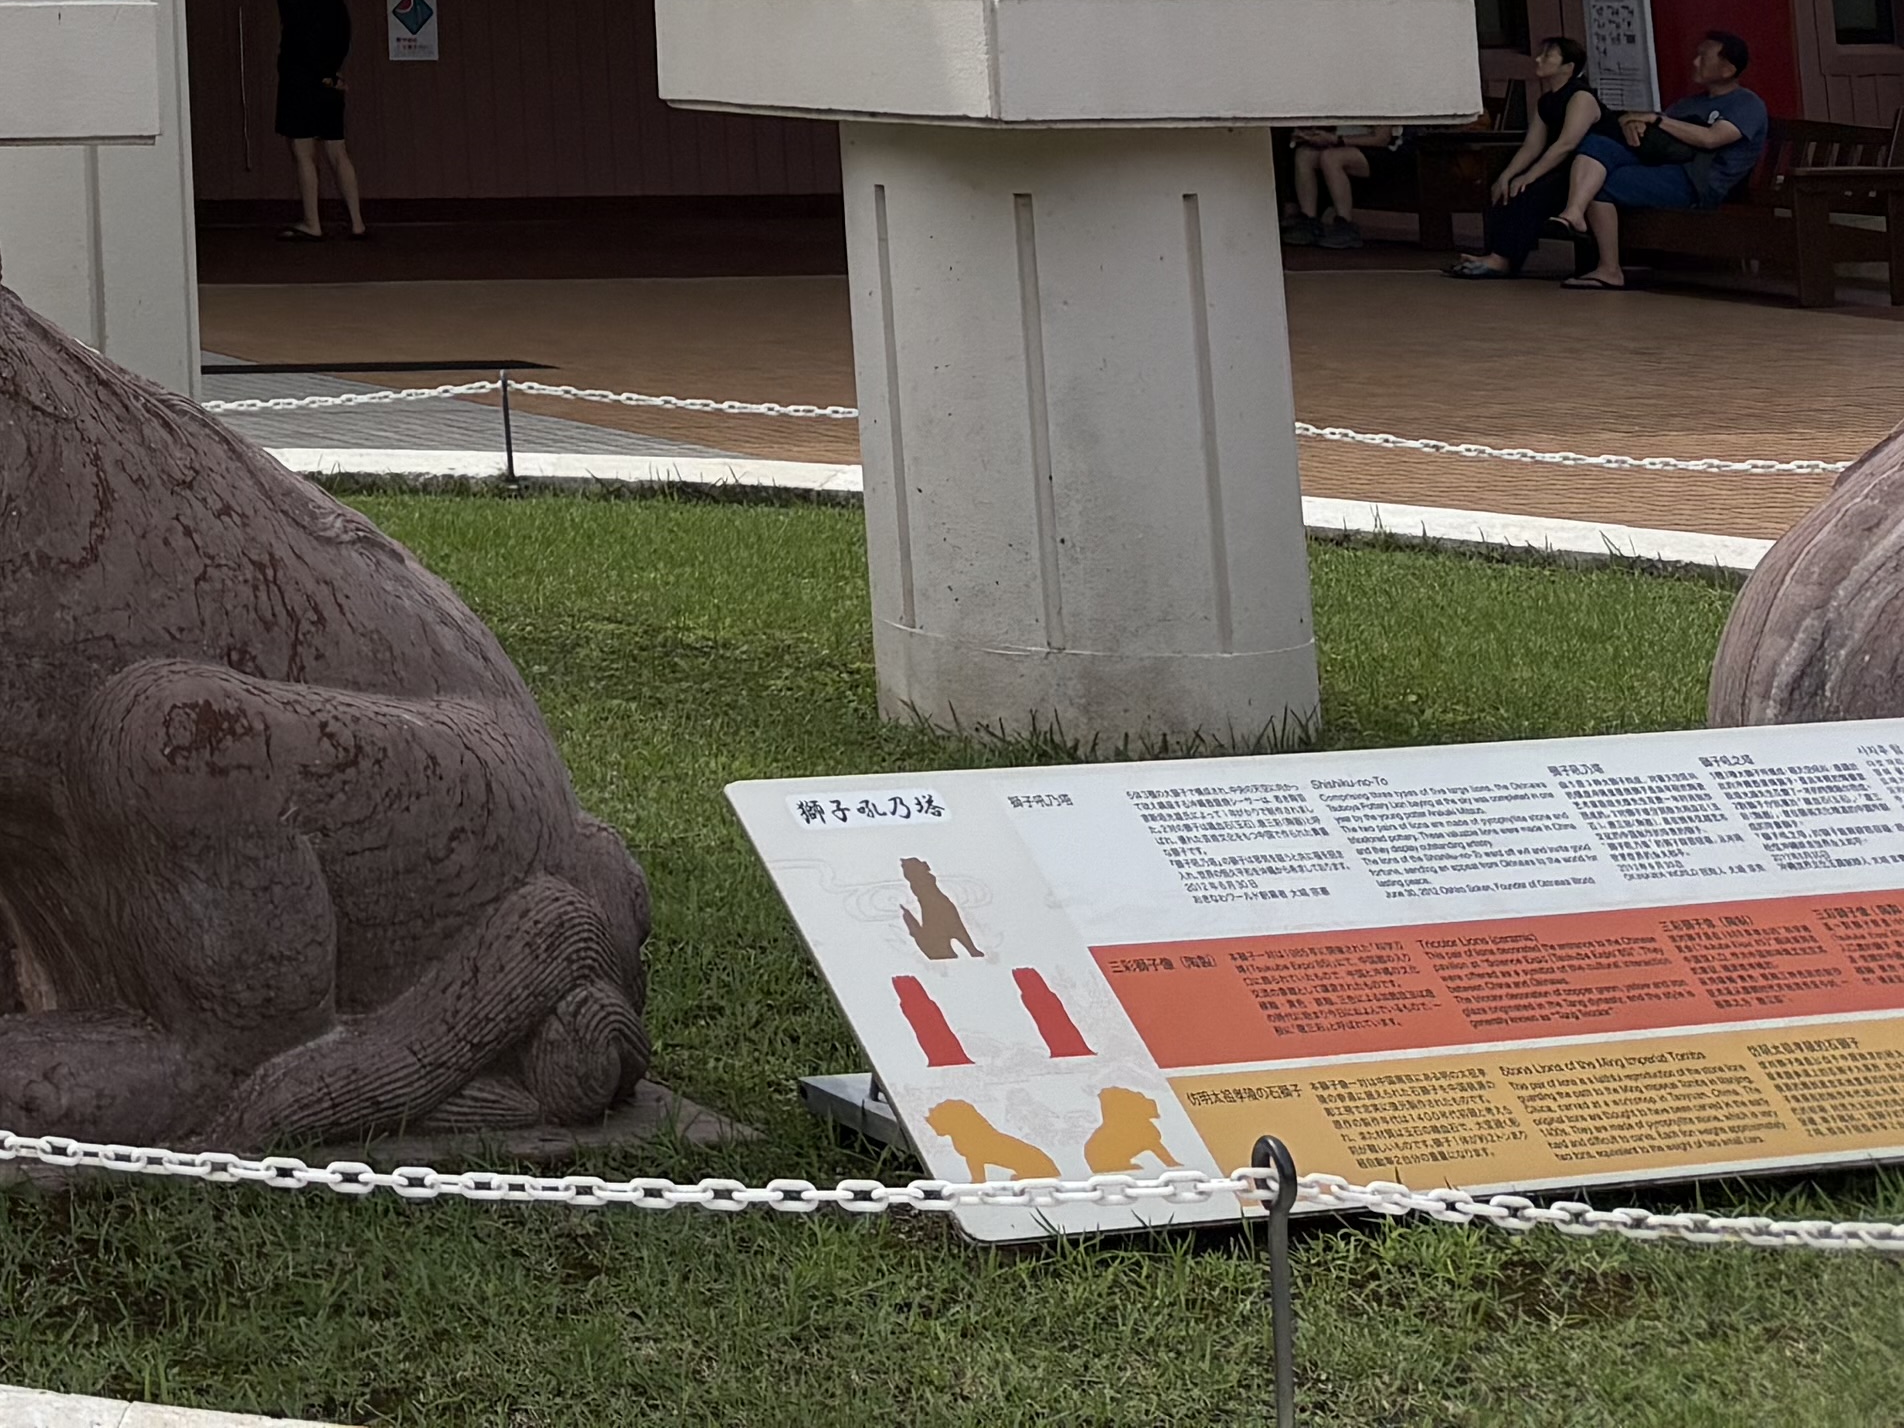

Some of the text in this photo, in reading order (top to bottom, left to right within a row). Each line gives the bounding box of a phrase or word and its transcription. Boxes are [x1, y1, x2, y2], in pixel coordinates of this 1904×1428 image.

[796, 794, 946, 825] 獅子吼乃塔
